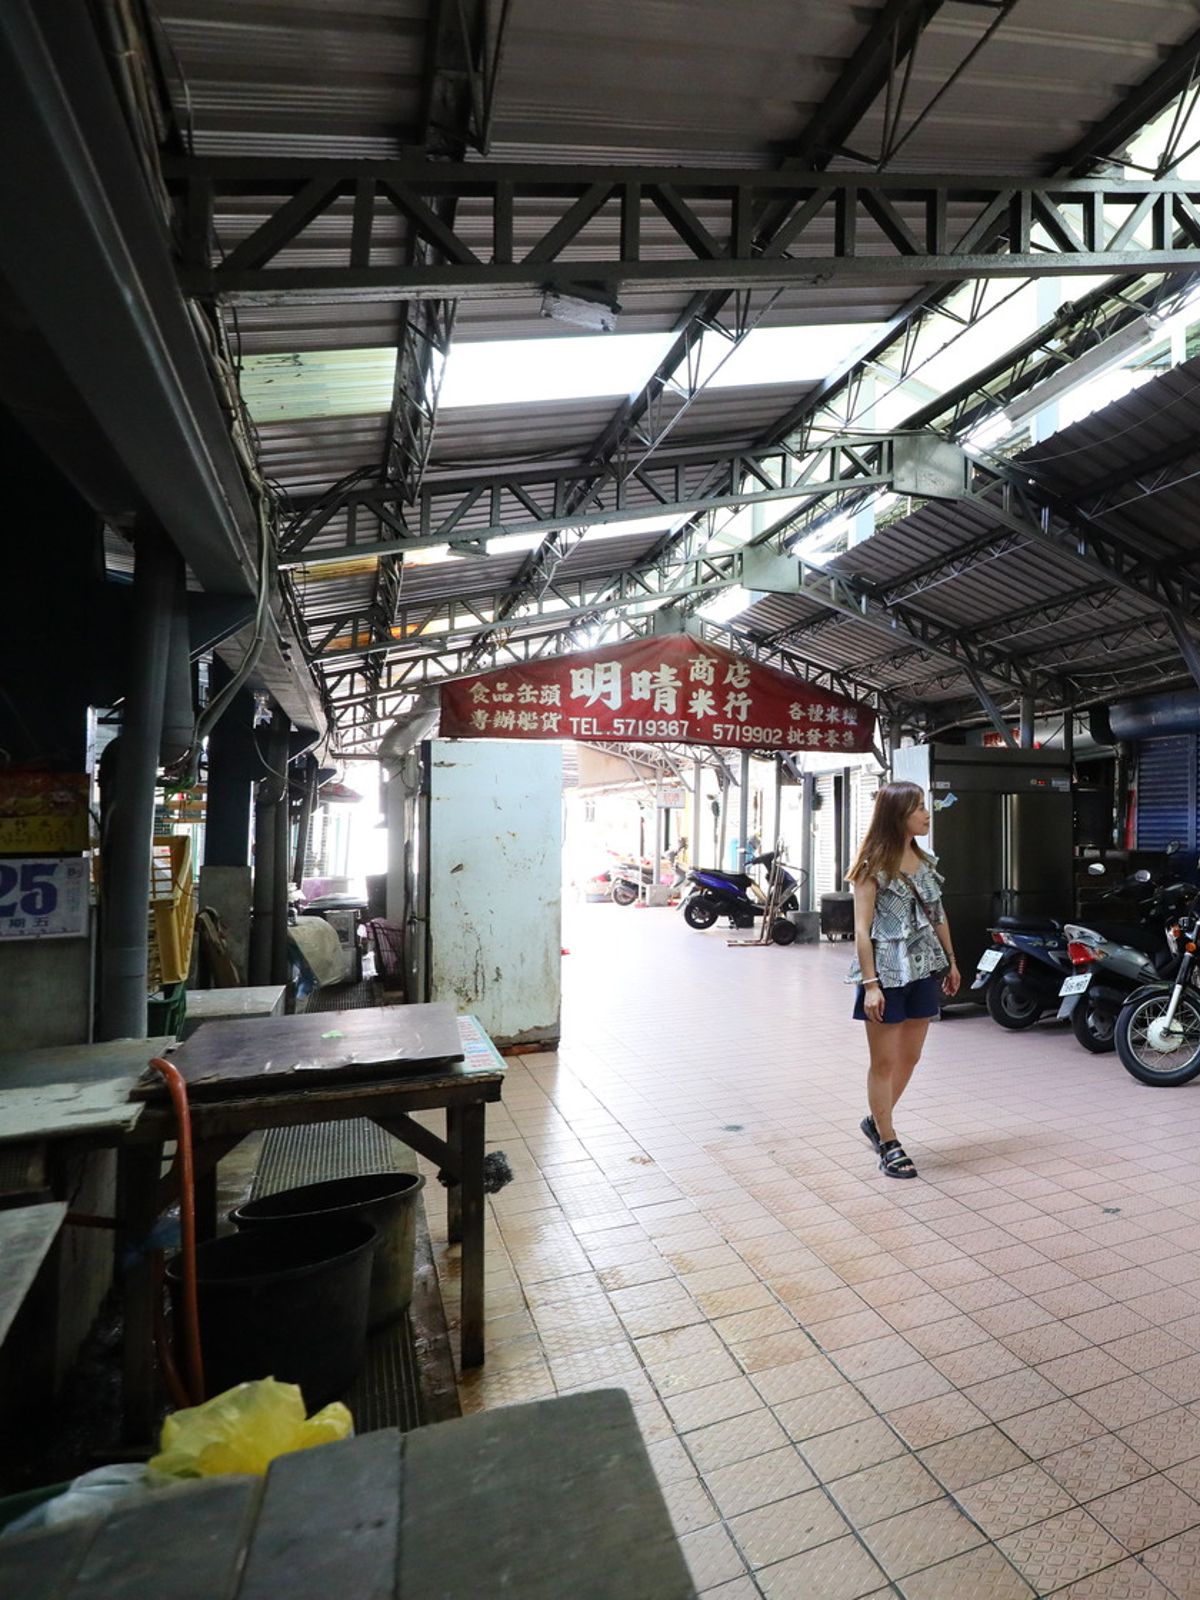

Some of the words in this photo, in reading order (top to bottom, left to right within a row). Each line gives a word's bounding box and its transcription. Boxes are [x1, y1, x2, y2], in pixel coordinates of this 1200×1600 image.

[569, 660, 682, 715] 明晴
[688, 654, 751, 688] 商店
[688, 688, 752, 722] 米行
[712, 724, 783, 744] 5719902
